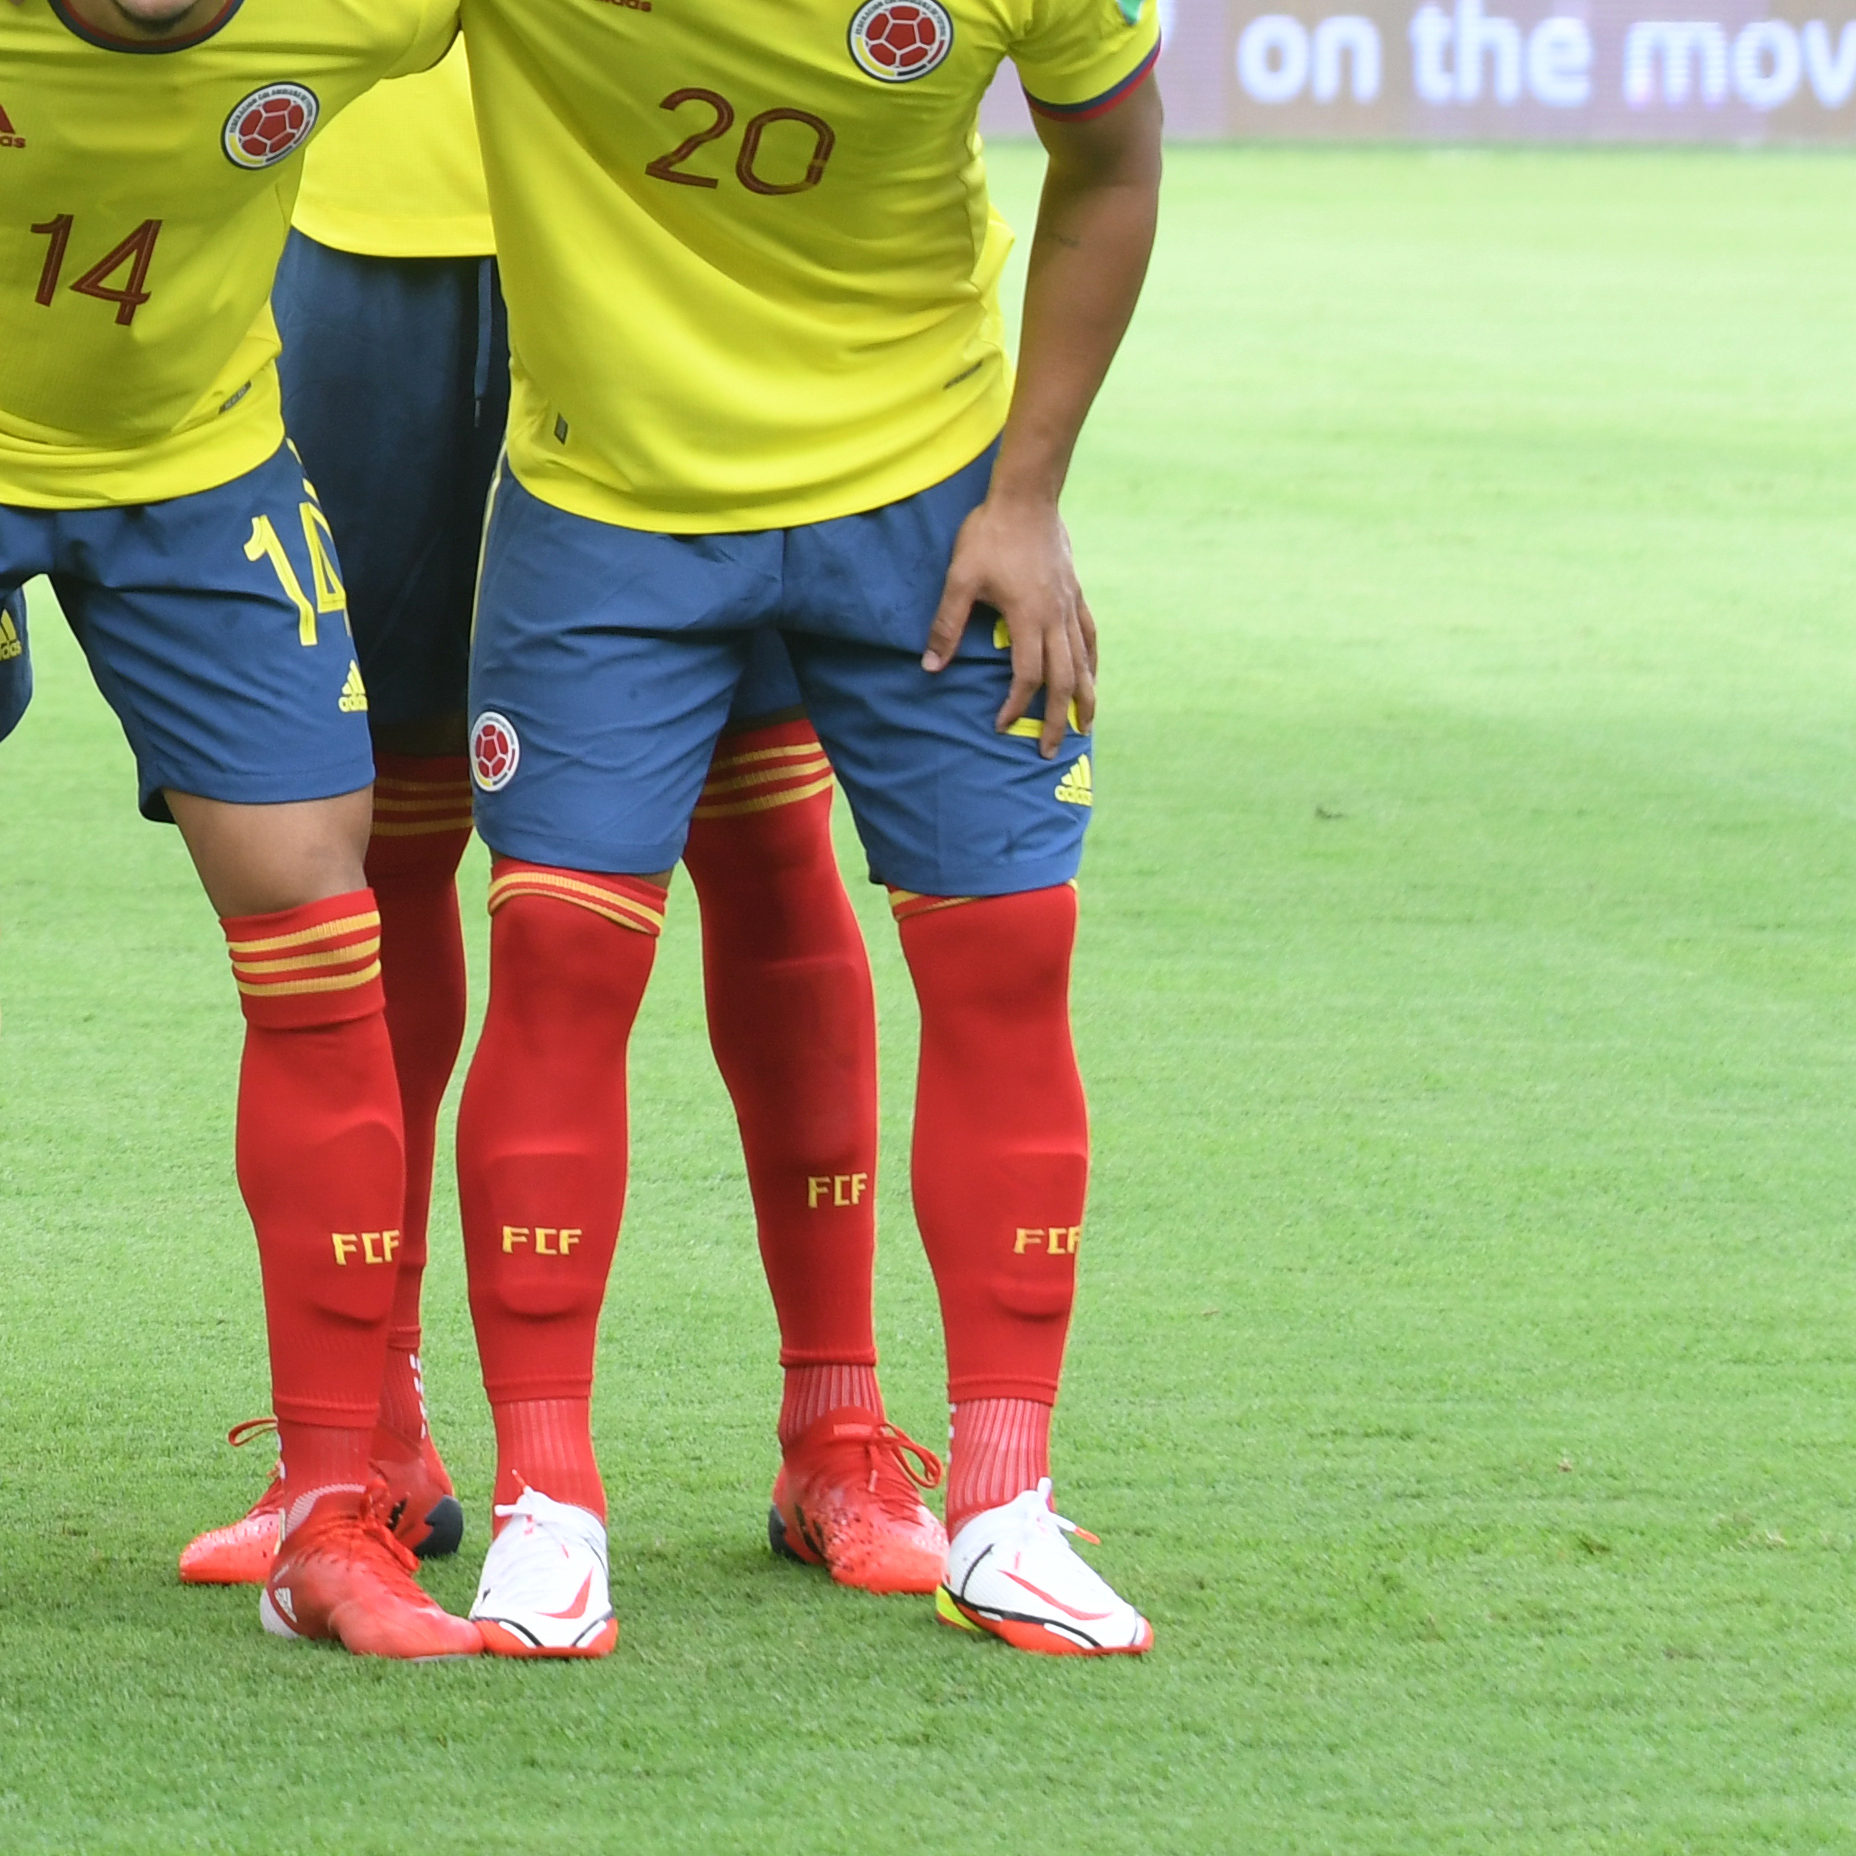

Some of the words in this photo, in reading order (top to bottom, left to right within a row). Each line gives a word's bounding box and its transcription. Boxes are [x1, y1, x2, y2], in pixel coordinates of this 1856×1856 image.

[1235, 14, 1383, 105] on
[644, 87, 836, 196] 20
[30, 213, 163, 327] 14
[244, 501, 350, 647] 14
[806, 1171, 869, 1209] FCF
[332, 1230, 401, 1266] FCF
[501, 1224, 583, 1257] FCF
[1013, 1223, 1081, 1256] FCF
